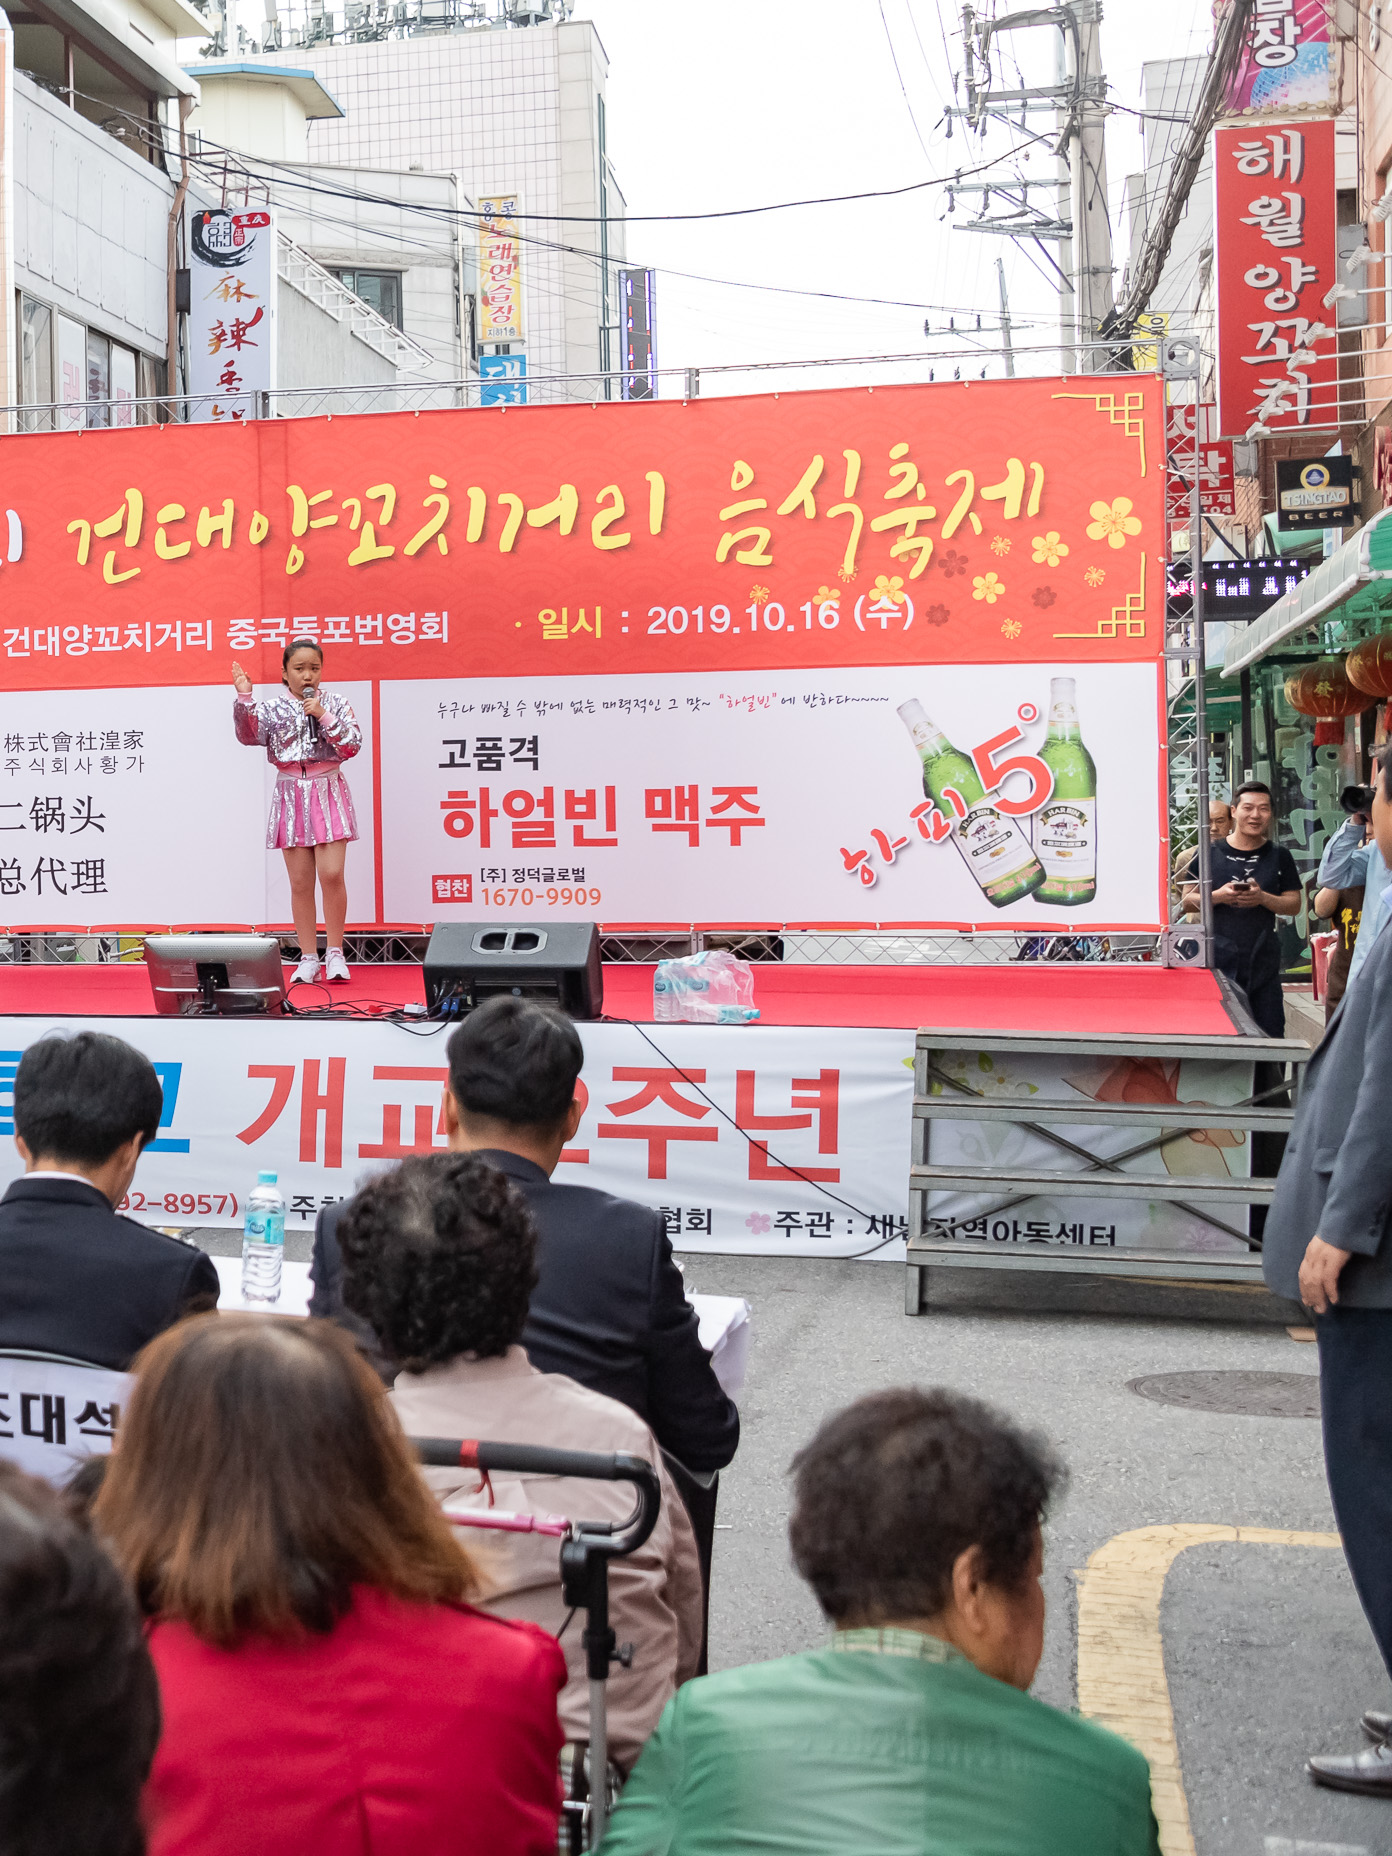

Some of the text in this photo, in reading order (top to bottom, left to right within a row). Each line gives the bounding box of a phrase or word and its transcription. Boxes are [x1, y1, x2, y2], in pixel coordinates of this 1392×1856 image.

[482, 201, 517, 222] 홍콩
[487, 222, 516, 325] 노래연습장
[487, 327, 517, 338] 지하1층
[1283, 490, 1347, 507] TSINGTAO
[66, 470, 667, 585] 건대양꼬치거리
[714, 442, 1046, 581] 음식축제
[1288, 511, 1344, 522] BEER
[537, 594, 916, 640] 일시 2019.10.16 (수)
[2, 618, 214, 658] 건대양꼬치거리
[225, 610, 451, 650] 중국동포번영회
[436, 703, 476, 719] 누구나
[481, 700, 511, 718] 빠질
[515, 699, 527, 716] 수
[533, 699, 564, 716] 밖에
[569, 698, 597, 715] 없는
[602, 697, 663, 716] 매력적인
[667, 698, 679, 711] 그
[3, 729, 145, 754] 株式會社湟家
[437, 735, 541, 772] 고품격
[3, 755, 146, 777] 주식회사황가
[438, 783, 767, 849] 하얼빈 맥주
[961, 808, 991, 828] HARBIN
[1047, 806, 1081, 817] HARBIN
[480, 867, 586, 884] [주] 정덕글로벌
[434, 878, 470, 898] 협찬
[481, 887, 602, 907] 1670-9909
[773, 1210, 835, 1240] 주관
